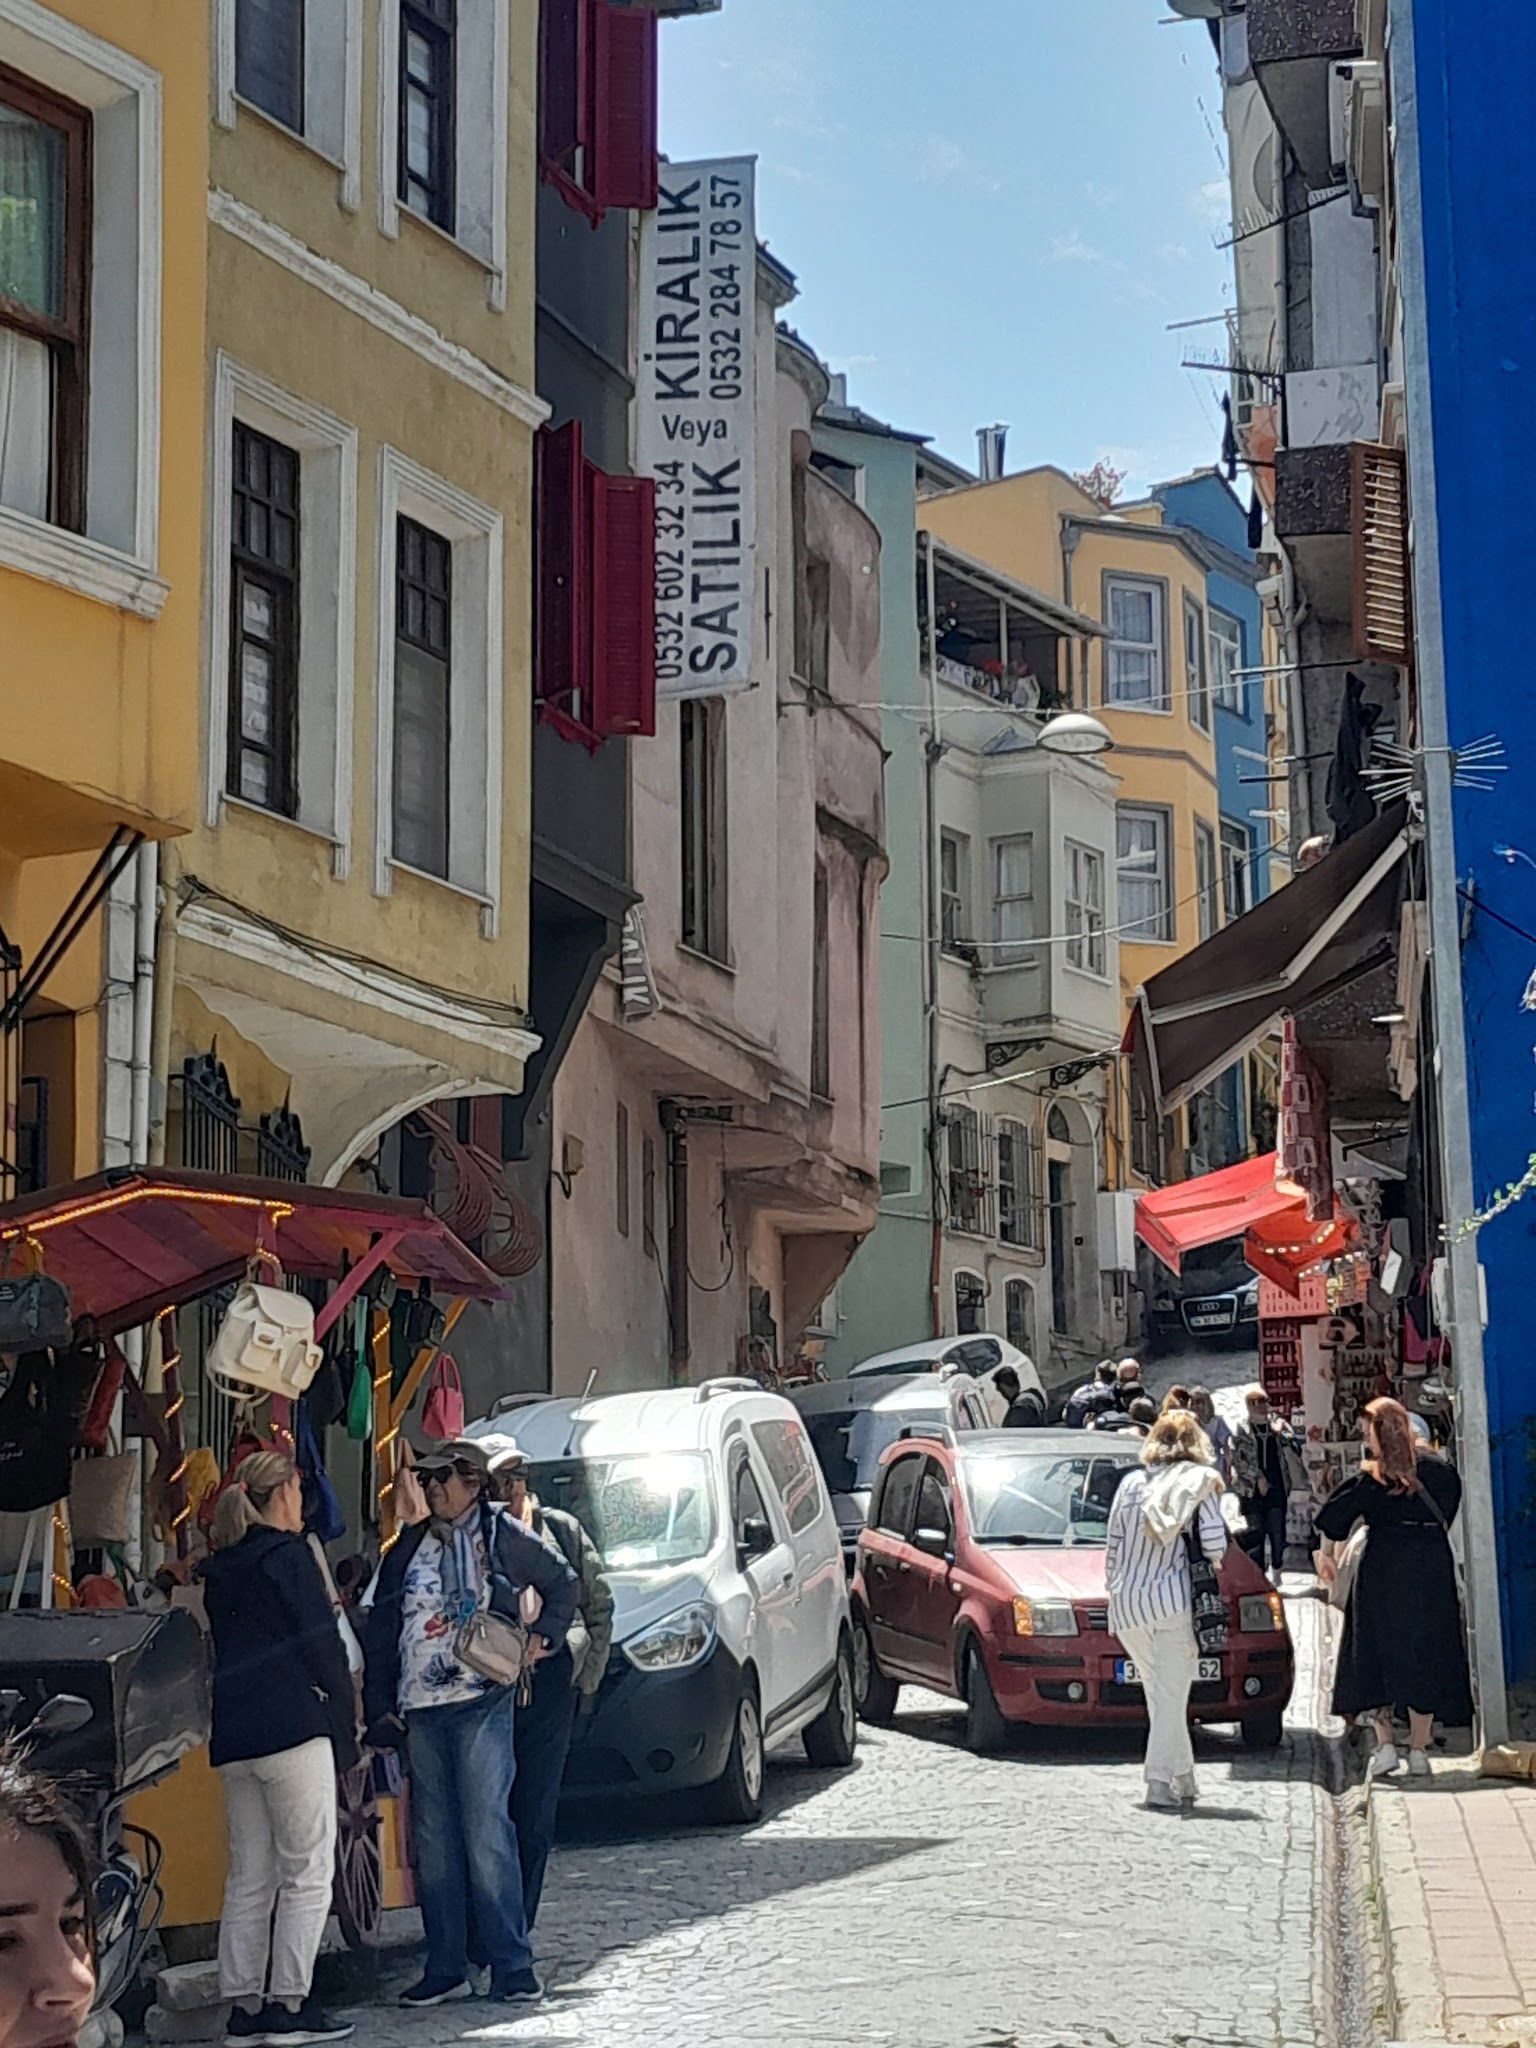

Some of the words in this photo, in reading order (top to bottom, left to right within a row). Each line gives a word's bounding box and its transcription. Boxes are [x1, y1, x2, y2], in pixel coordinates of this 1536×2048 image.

[709, 175, 742, 209] 57
[709, 218, 742, 256] 78
[644, 177, 701, 400] KİRALIK
[709, 264, 741, 319] 284
[709, 327, 742, 400] 0532
[662, 414, 728, 448] Veya
[654, 460, 685, 495] 34
[655, 505, 685, 540] 32
[655, 550, 684, 600] 602
[689, 458, 742, 675] SATILIK
[655, 611, 684, 680] 0532
[1198, 1660, 1219, 1679] 62
